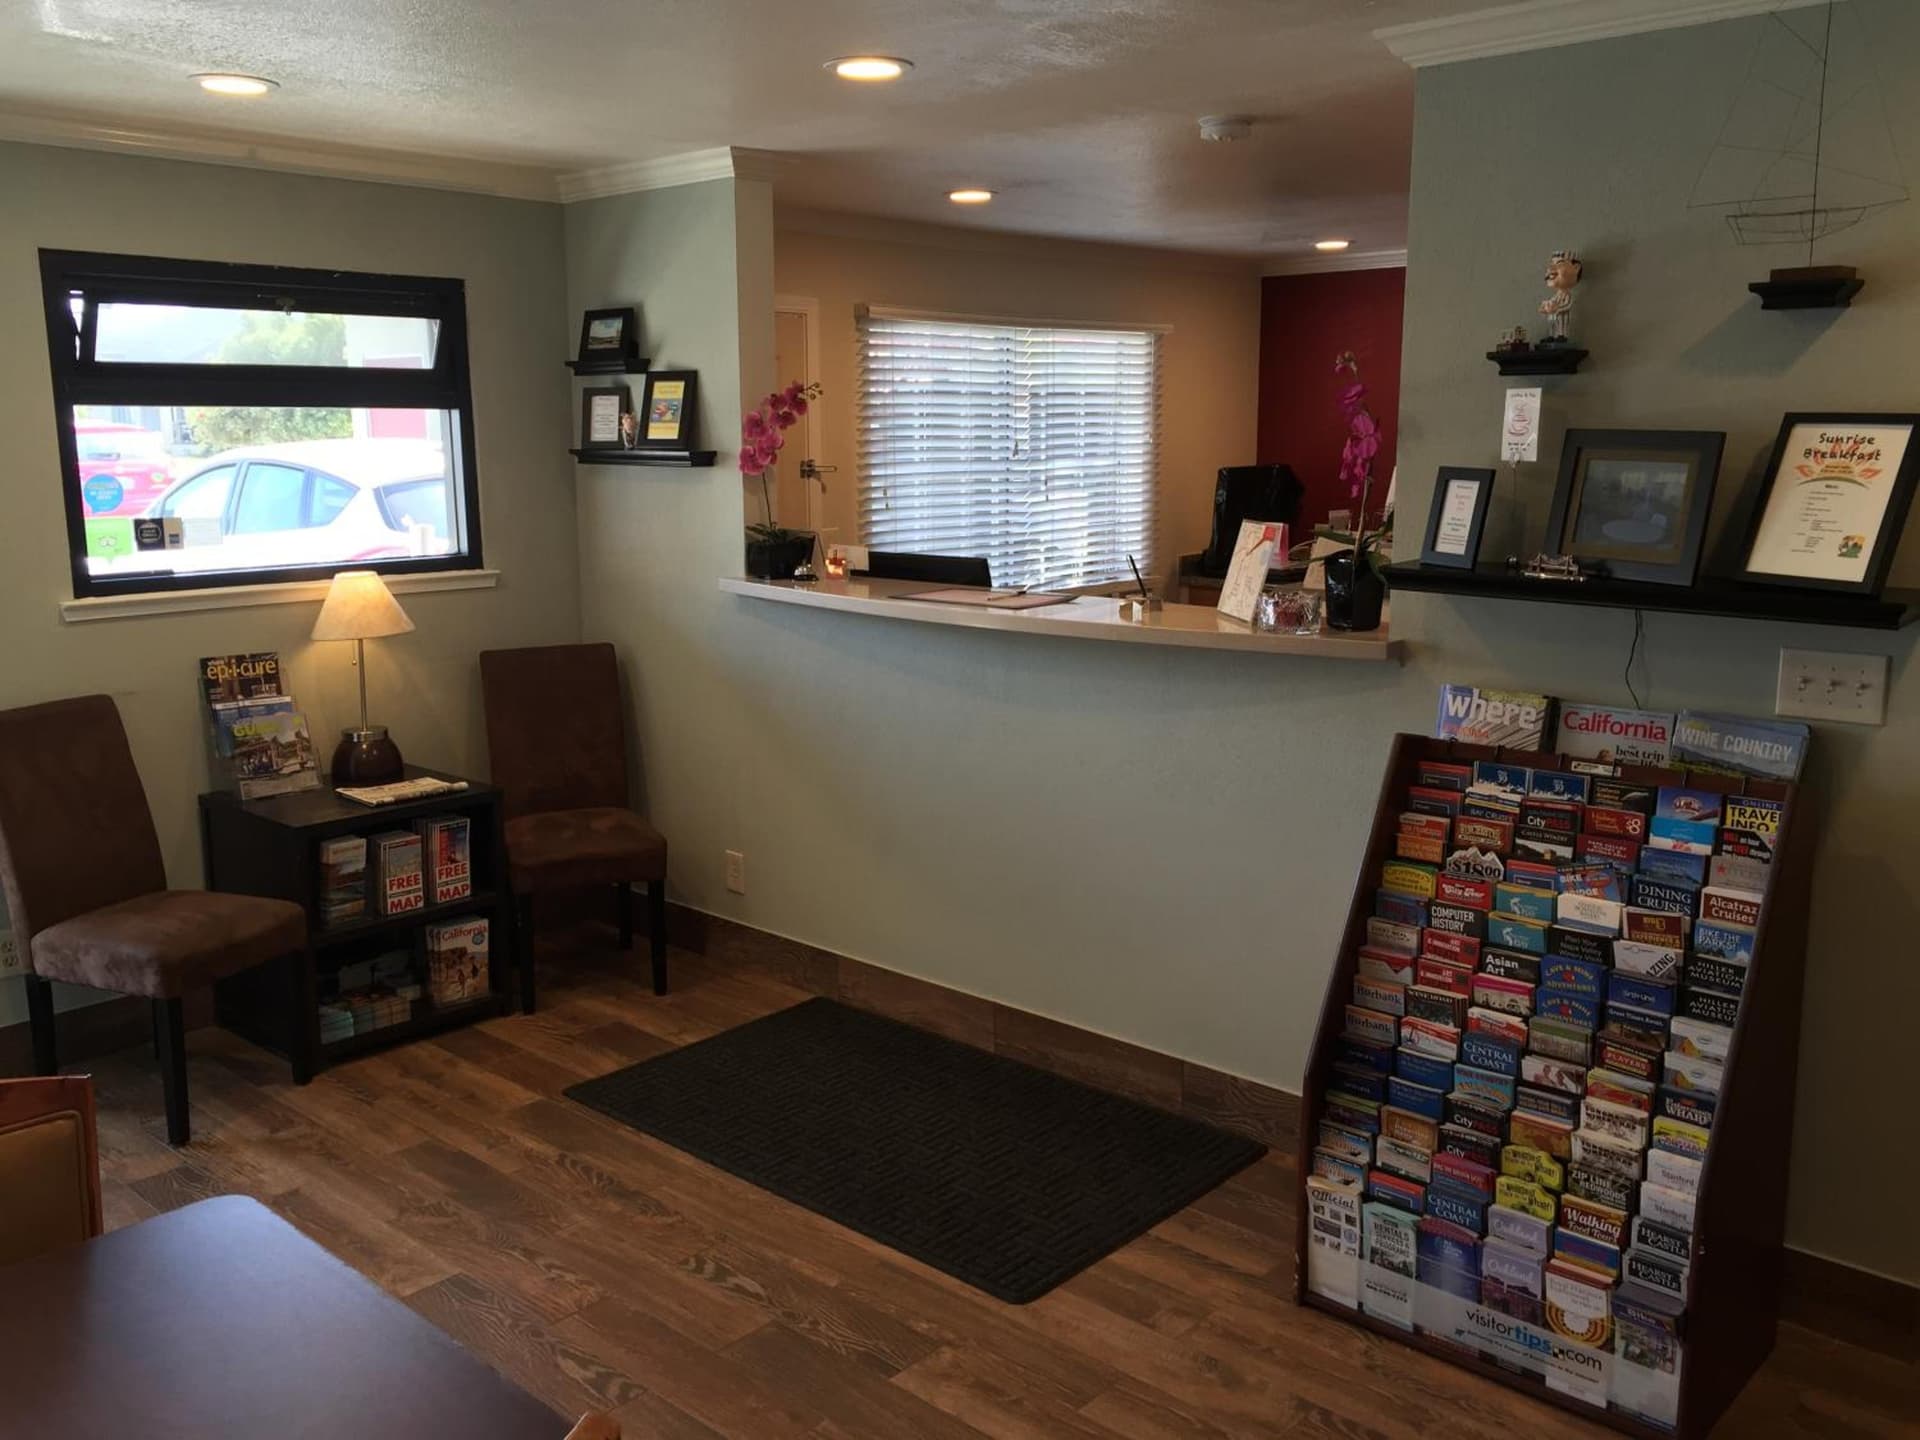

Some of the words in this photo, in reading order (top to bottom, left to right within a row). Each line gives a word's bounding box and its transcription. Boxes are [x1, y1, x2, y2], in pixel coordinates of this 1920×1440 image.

[1818, 432, 1875, 445] Sunrise
[1803, 448, 1881, 462] Breakfast
[1447, 688, 1538, 731] where
[1563, 710, 1667, 743] California
[1615, 744, 1641, 758] best
[1642, 749, 1664, 762] trip
[1680, 727, 1720, 748] WINE
[1722, 735, 1793, 762] COUNTRY
[438, 862, 468, 880] FREE
[388, 874, 421, 892] FREE
[438, 884, 470, 902] MAP
[1638, 884, 1692, 905] DINING
[390, 895, 423, 913] MAP
[1637, 896, 1692, 915] CRUISES
[1709, 896, 1759, 914] Alcatraz
[1431, 905, 1475, 923] COMPUTER
[1711, 908, 1755, 925] Cruises
[441, 925, 487, 942] California
[1431, 917, 1465, 932] HISTORY
[1485, 953, 1519, 969] Asian
[1485, 964, 1505, 977] Art
[1689, 972, 1742, 988] MUSEUM
[1689, 1000, 1738, 1015] AVIATIO
[1691, 1008, 1736, 1021] MUSEU
[1463, 1041, 1514, 1063] CENTRAL
[1470, 1055, 1506, 1071] COAST
[1571, 1171, 1588, 1181] ZIP
[1311, 1189, 1354, 1209] Official
[1428, 1194, 1479, 1219] CENTRAL
[1434, 1207, 1471, 1227] COAST
[1563, 1206, 1622, 1238] Walking
[1568, 1222, 1591, 1236] Food
[1640, 1226, 1683, 1247] HEARST
[1648, 1236, 1689, 1257] CASTLE
[1631, 1260, 1674, 1280] HEARST
[1638, 1271, 1680, 1290] CASTLE
